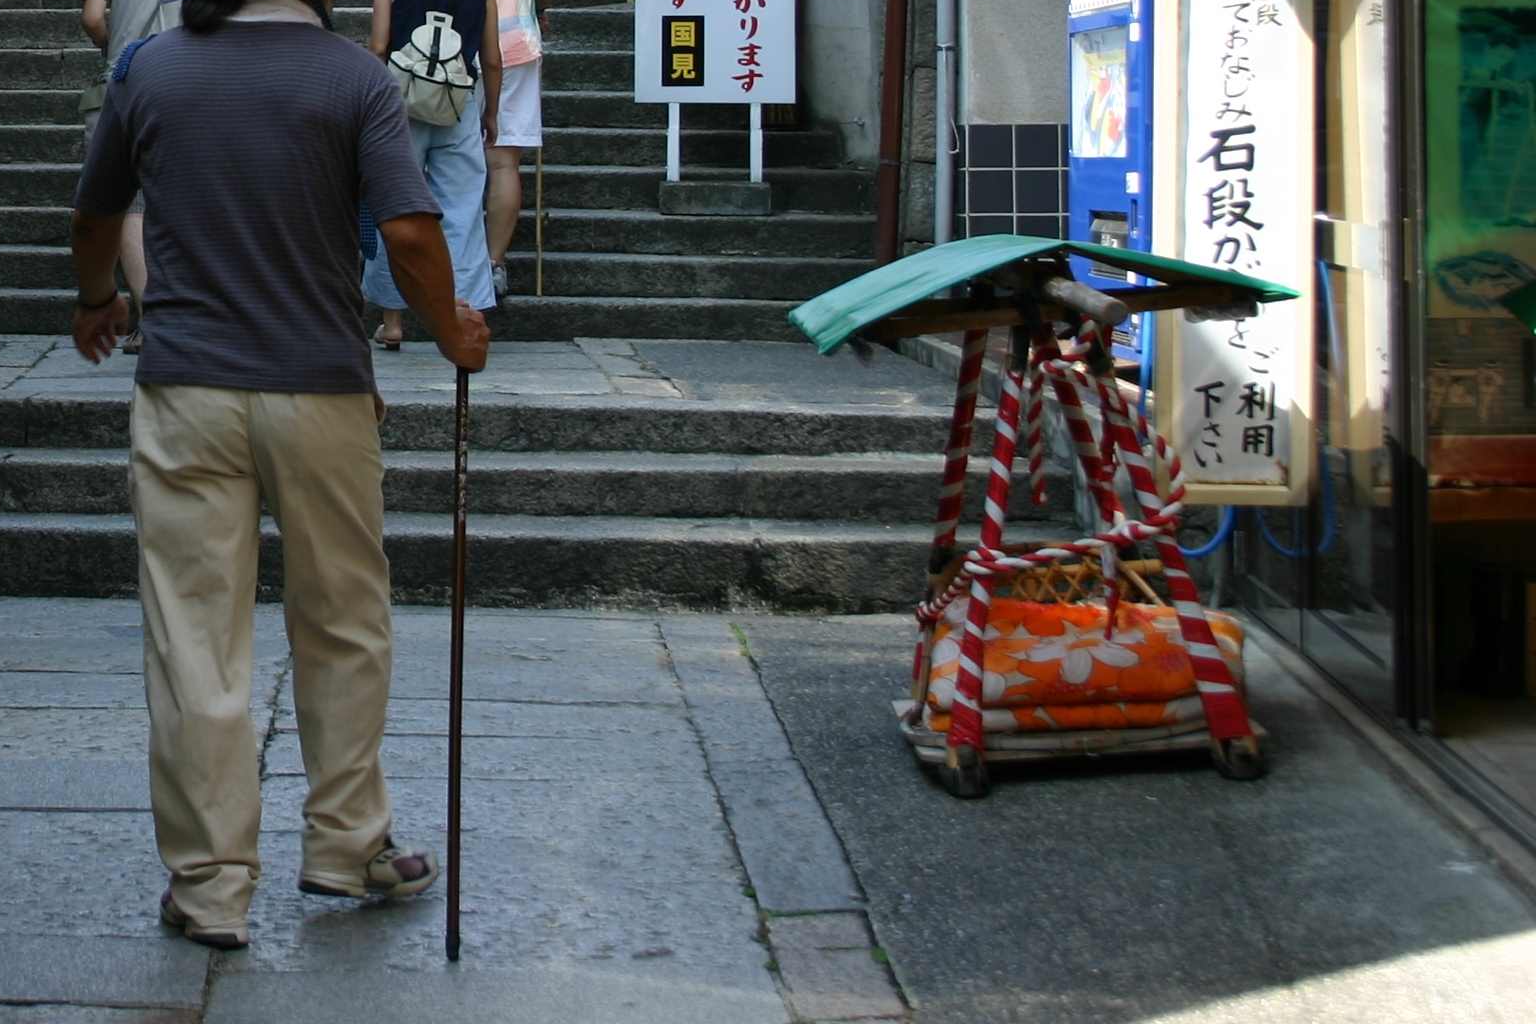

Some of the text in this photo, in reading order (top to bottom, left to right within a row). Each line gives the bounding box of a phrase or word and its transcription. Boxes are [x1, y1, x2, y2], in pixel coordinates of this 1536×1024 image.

[670, 21, 696, 80] 国見
[1193, 381, 1226, 469] 下さい
